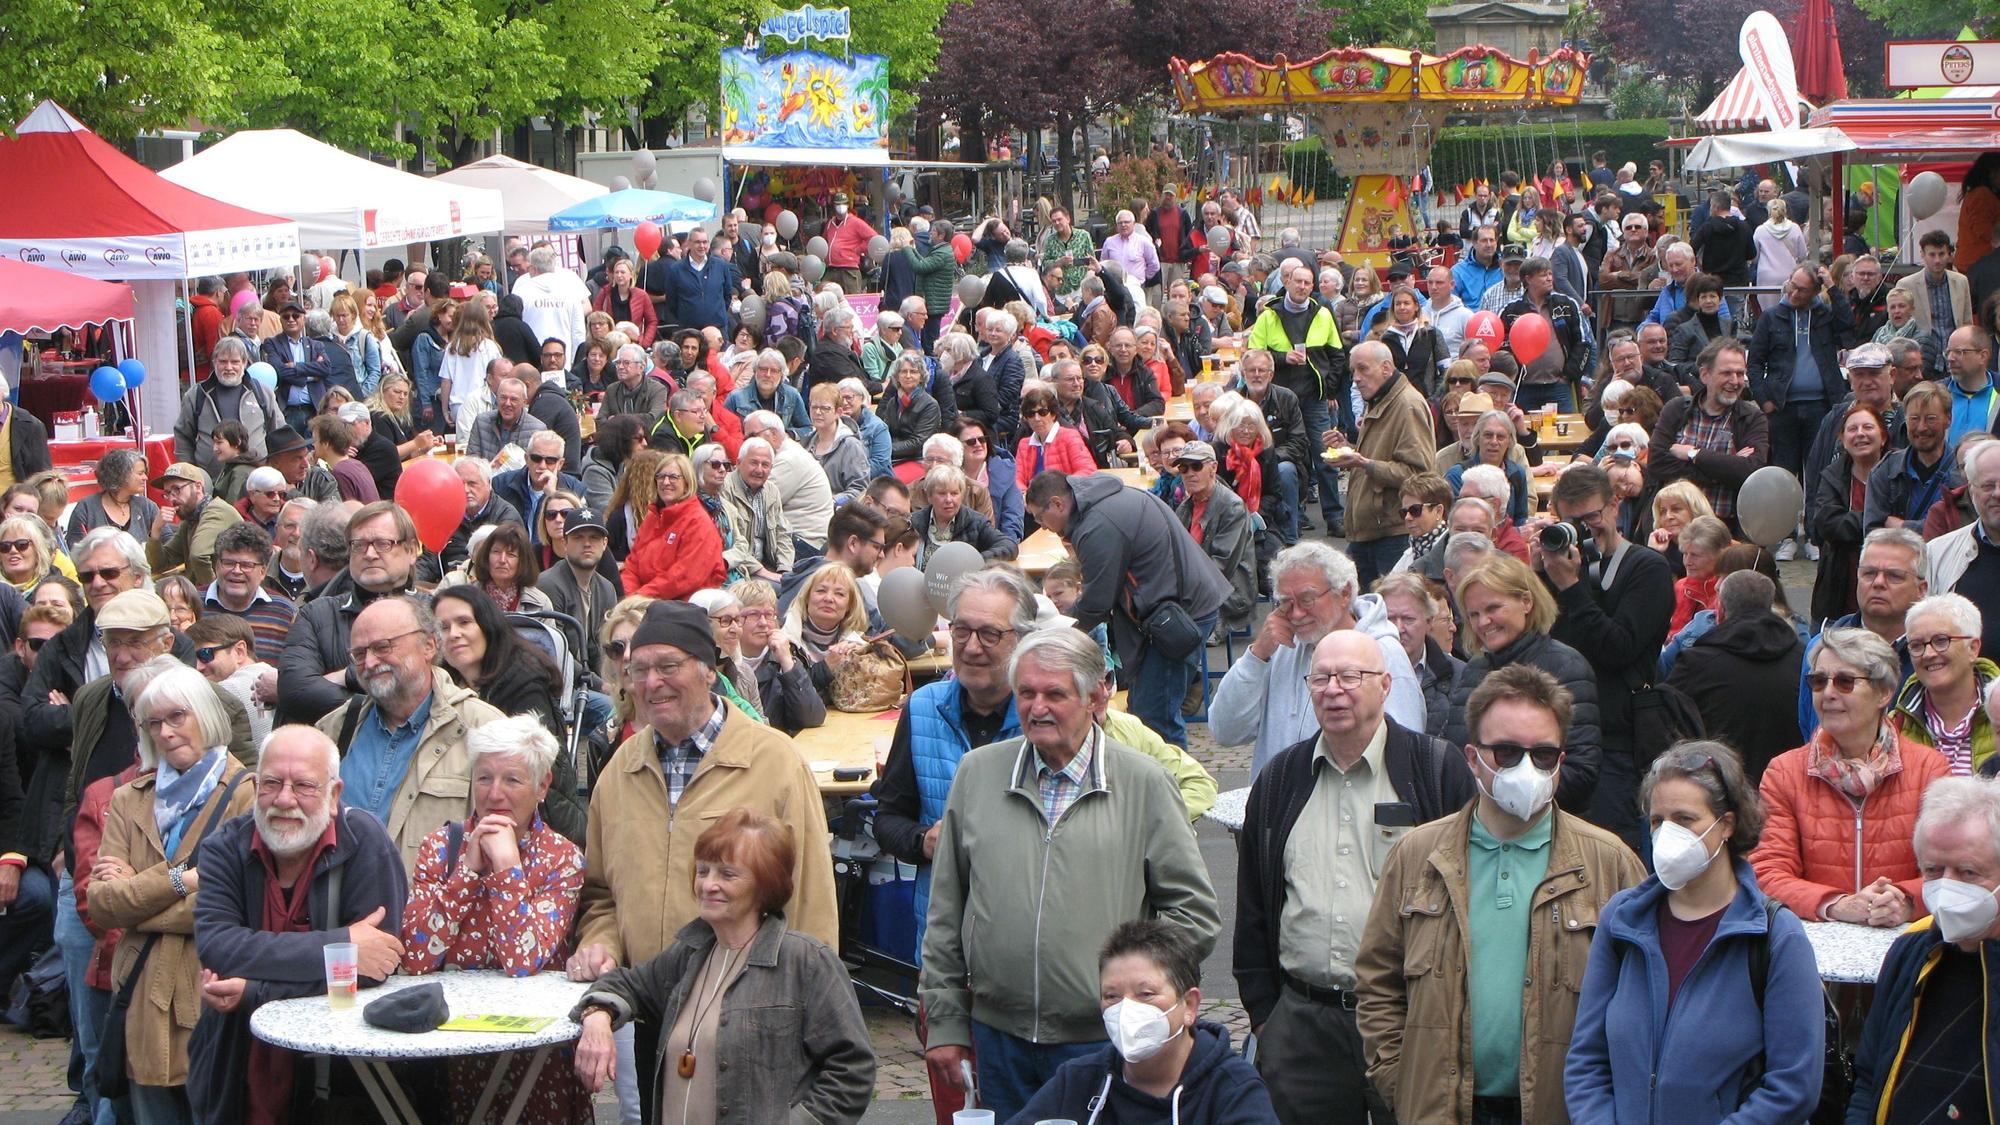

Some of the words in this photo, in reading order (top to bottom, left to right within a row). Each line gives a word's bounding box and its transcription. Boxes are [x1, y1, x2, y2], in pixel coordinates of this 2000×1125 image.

[1944, 61, 1970, 69] PETERS
[27, 253, 45, 263] AWO
[68, 253, 87, 262] AWO
[109, 253, 129, 261] AWO
[153, 252, 171, 261] AWO
[534, 298, 564, 308] Oliver
[935, 572, 949, 581] Wir
